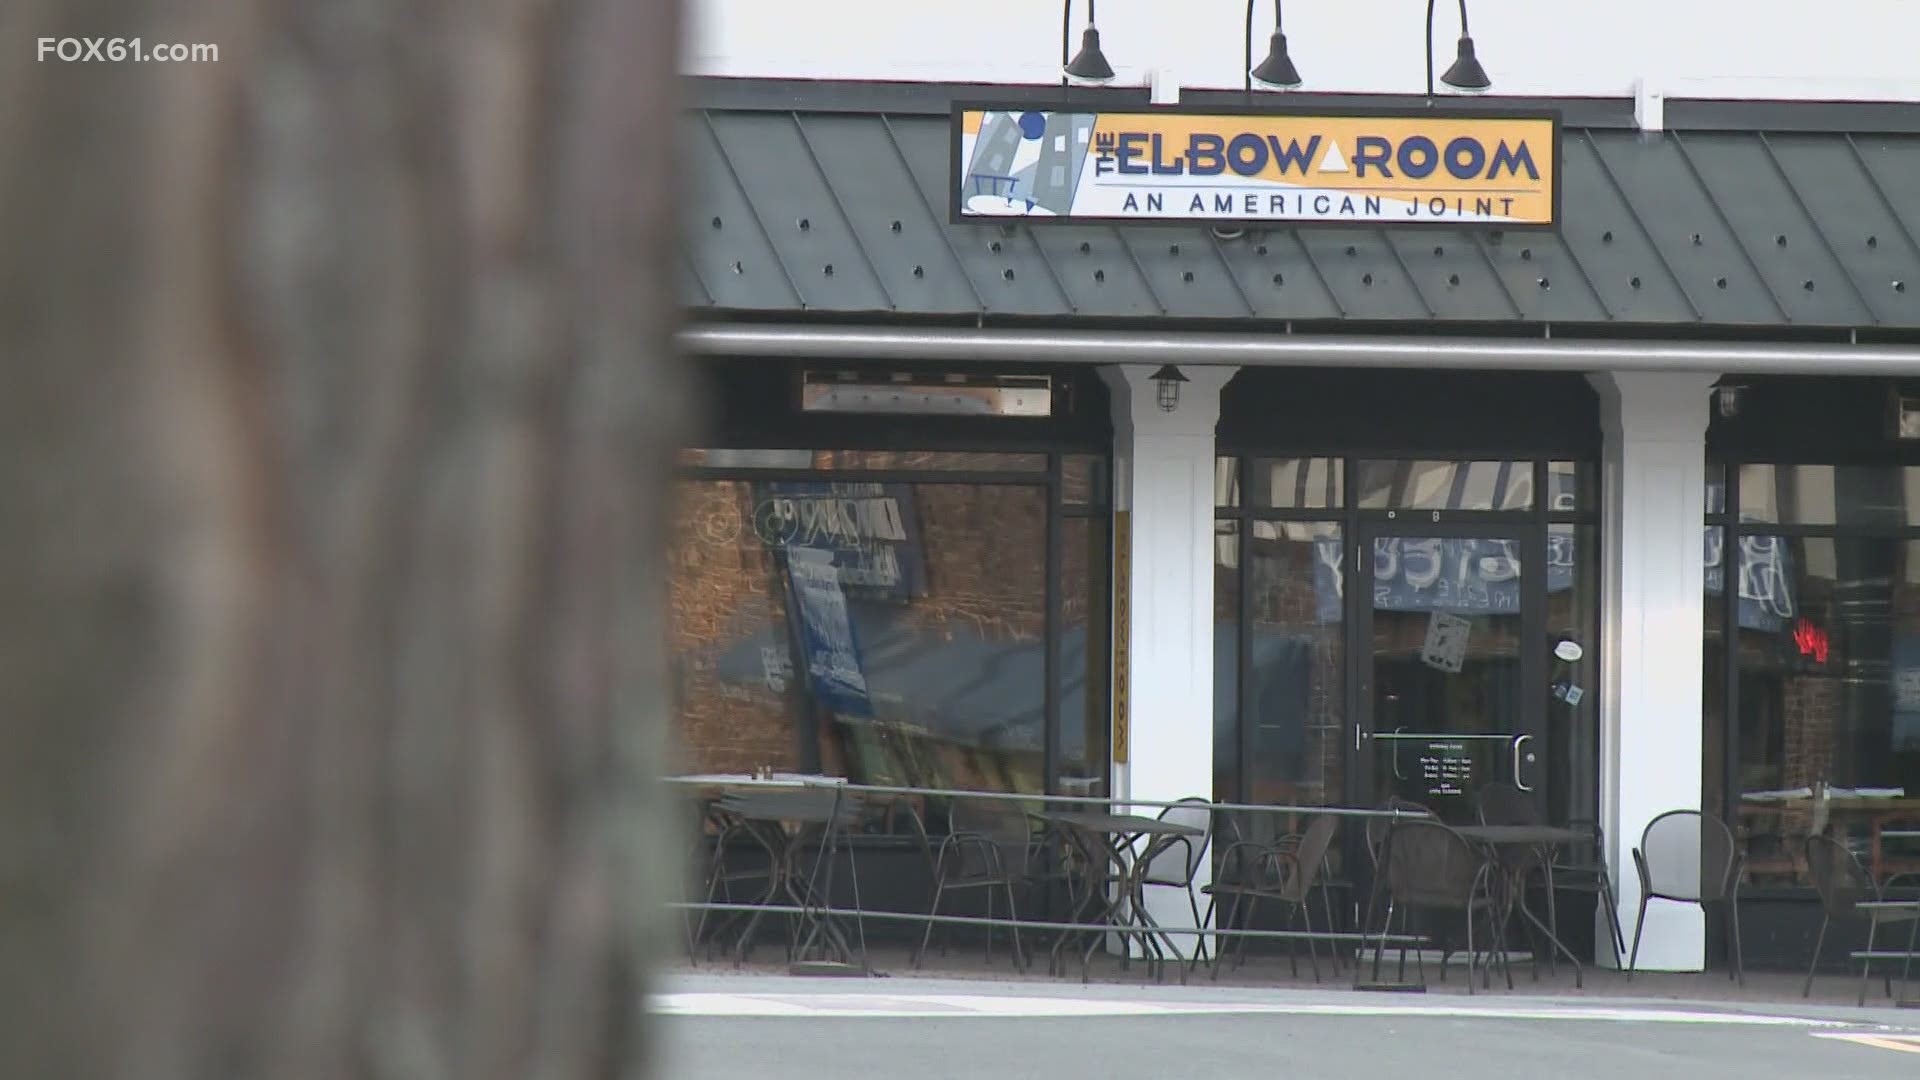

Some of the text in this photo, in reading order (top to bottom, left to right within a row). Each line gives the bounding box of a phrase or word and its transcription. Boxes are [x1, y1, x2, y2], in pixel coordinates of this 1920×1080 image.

[1096, 131, 1540, 180] THE ELBOW ROOM
[1122, 192, 1514, 216] AN AMERICAN JOINT
